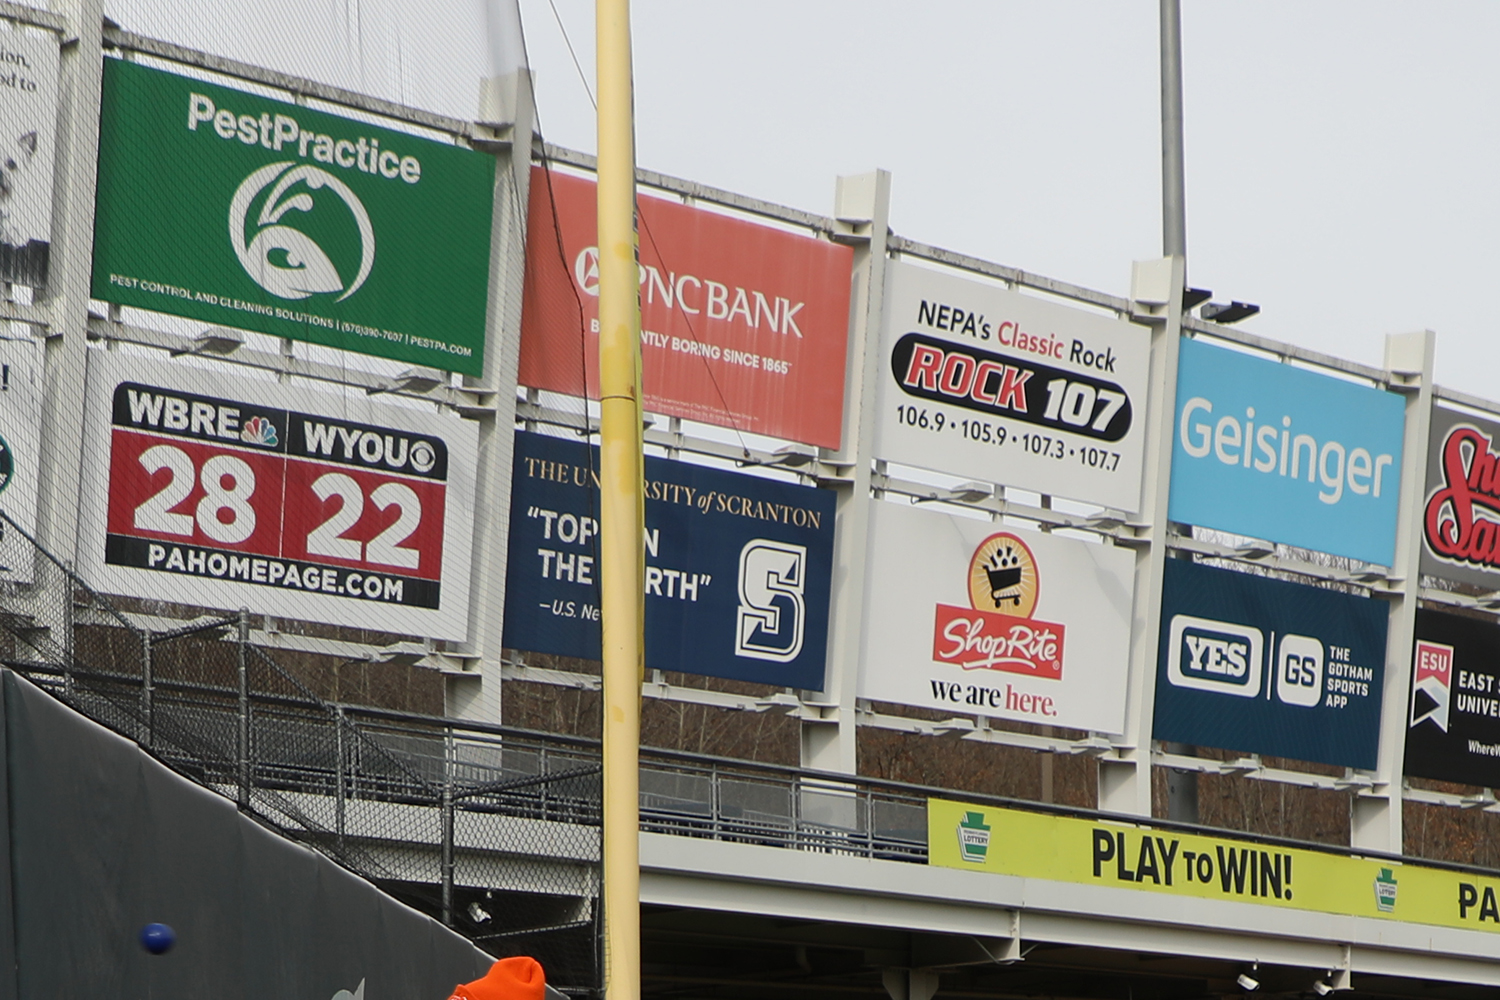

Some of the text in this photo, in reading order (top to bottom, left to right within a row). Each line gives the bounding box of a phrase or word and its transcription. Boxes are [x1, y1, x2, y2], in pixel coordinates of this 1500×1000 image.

[187, 92, 421, 184] PestPractice
[110, 273, 139, 289] PEST
[140, 280, 193, 300] CONTROL
[195, 292, 218, 305] AND
[220, 297, 273, 317] CLEANING
[275, 308, 334, 330] SOLUTIONS
[410, 336, 472, 357] PESTPA.COM
[704, 279, 805, 338] BANK
[671, 336, 721, 360] BORING
[723, 348, 760, 369] SINCE
[917, 300, 1117, 374] NEPA's Classic Rock
[903, 342, 1126, 433] ROCK 107
[127, 389, 410, 465] WBRE WYOU
[897, 404, 1122, 473] 106.9 105.9 107.3 107.7
[1180, 396, 1393, 505] Geisinger
[133, 444, 422, 570] 28 22
[524, 456, 821, 529] THE UNRSITY of SCRANTON
[644, 527, 660, 558] N
[147, 544, 404, 602] PAHOMEPAGE.COM
[538, 548, 711, 602] THE RTH”
[581, 604, 603, 622] Ne
[939, 617, 1058, 664] ShopRite
[1185, 634, 1316, 689] YES GS
[1328, 662, 1373, 682] GOTHAM
[1329, 645, 1351, 663] THE
[1420, 651, 1448, 673] ESU
[1459, 670, 1495, 693] EAST
[930, 679, 1058, 717] we are here.
[1325, 693, 1348, 710] APP
[1326, 678, 1369, 698] SPORTS
[1092, 828, 1179, 887] PLAY
[1216, 846, 1293, 901] WIN!
[1458, 882, 1500, 924] PA
